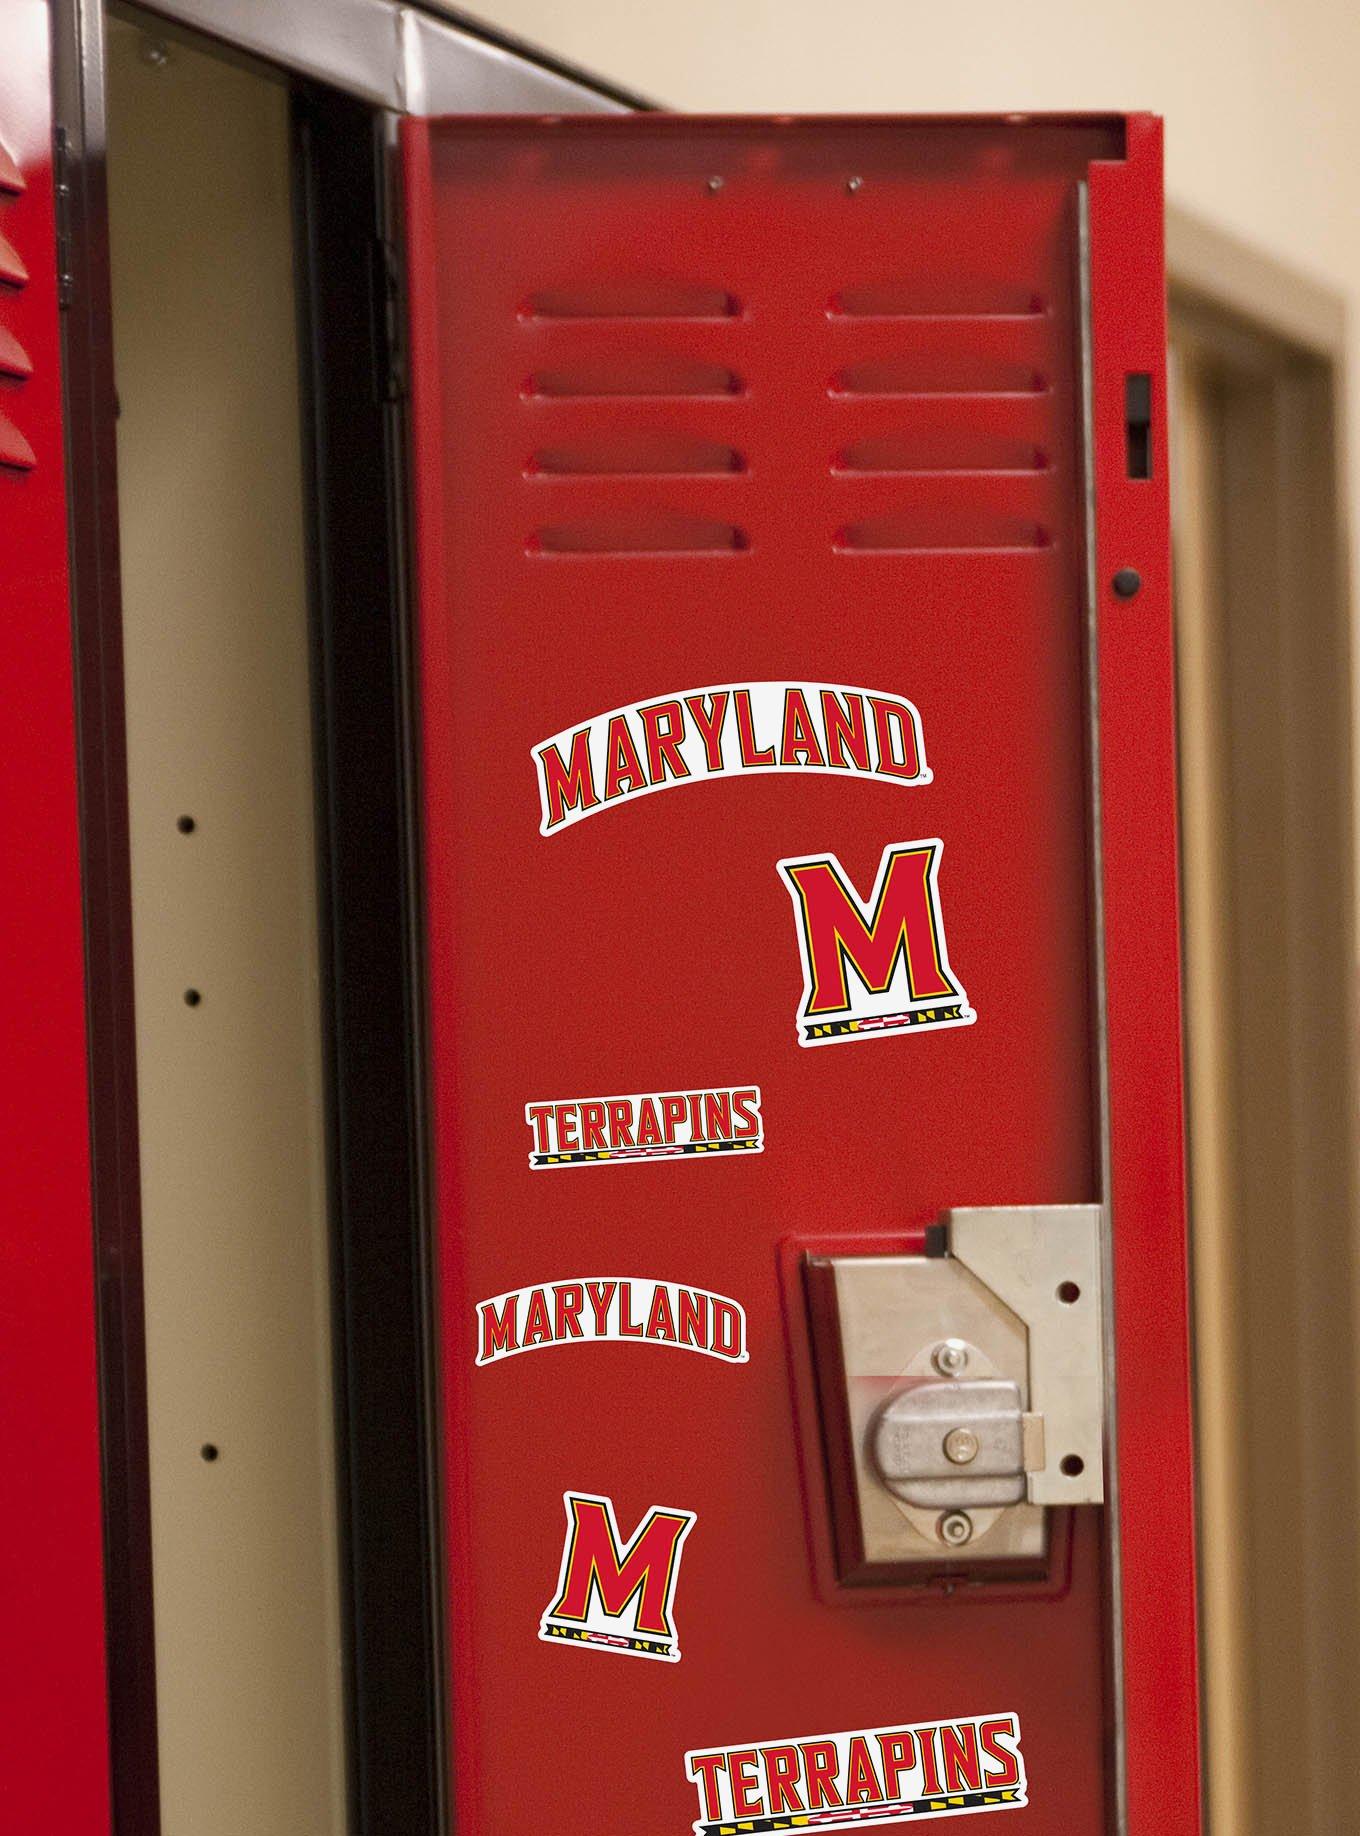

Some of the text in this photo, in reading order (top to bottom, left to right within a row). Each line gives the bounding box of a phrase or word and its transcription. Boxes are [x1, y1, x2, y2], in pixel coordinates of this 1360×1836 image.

[539, 688, 920, 829] MARYLAND
[784, 846, 958, 1016] M
[530, 1090, 759, 1154] TERRAPINS
[481, 1282, 741, 1360] MARYLAND
[549, 1498, 690, 1636] M
[692, 1719, 1019, 1822] TERRAPINS
